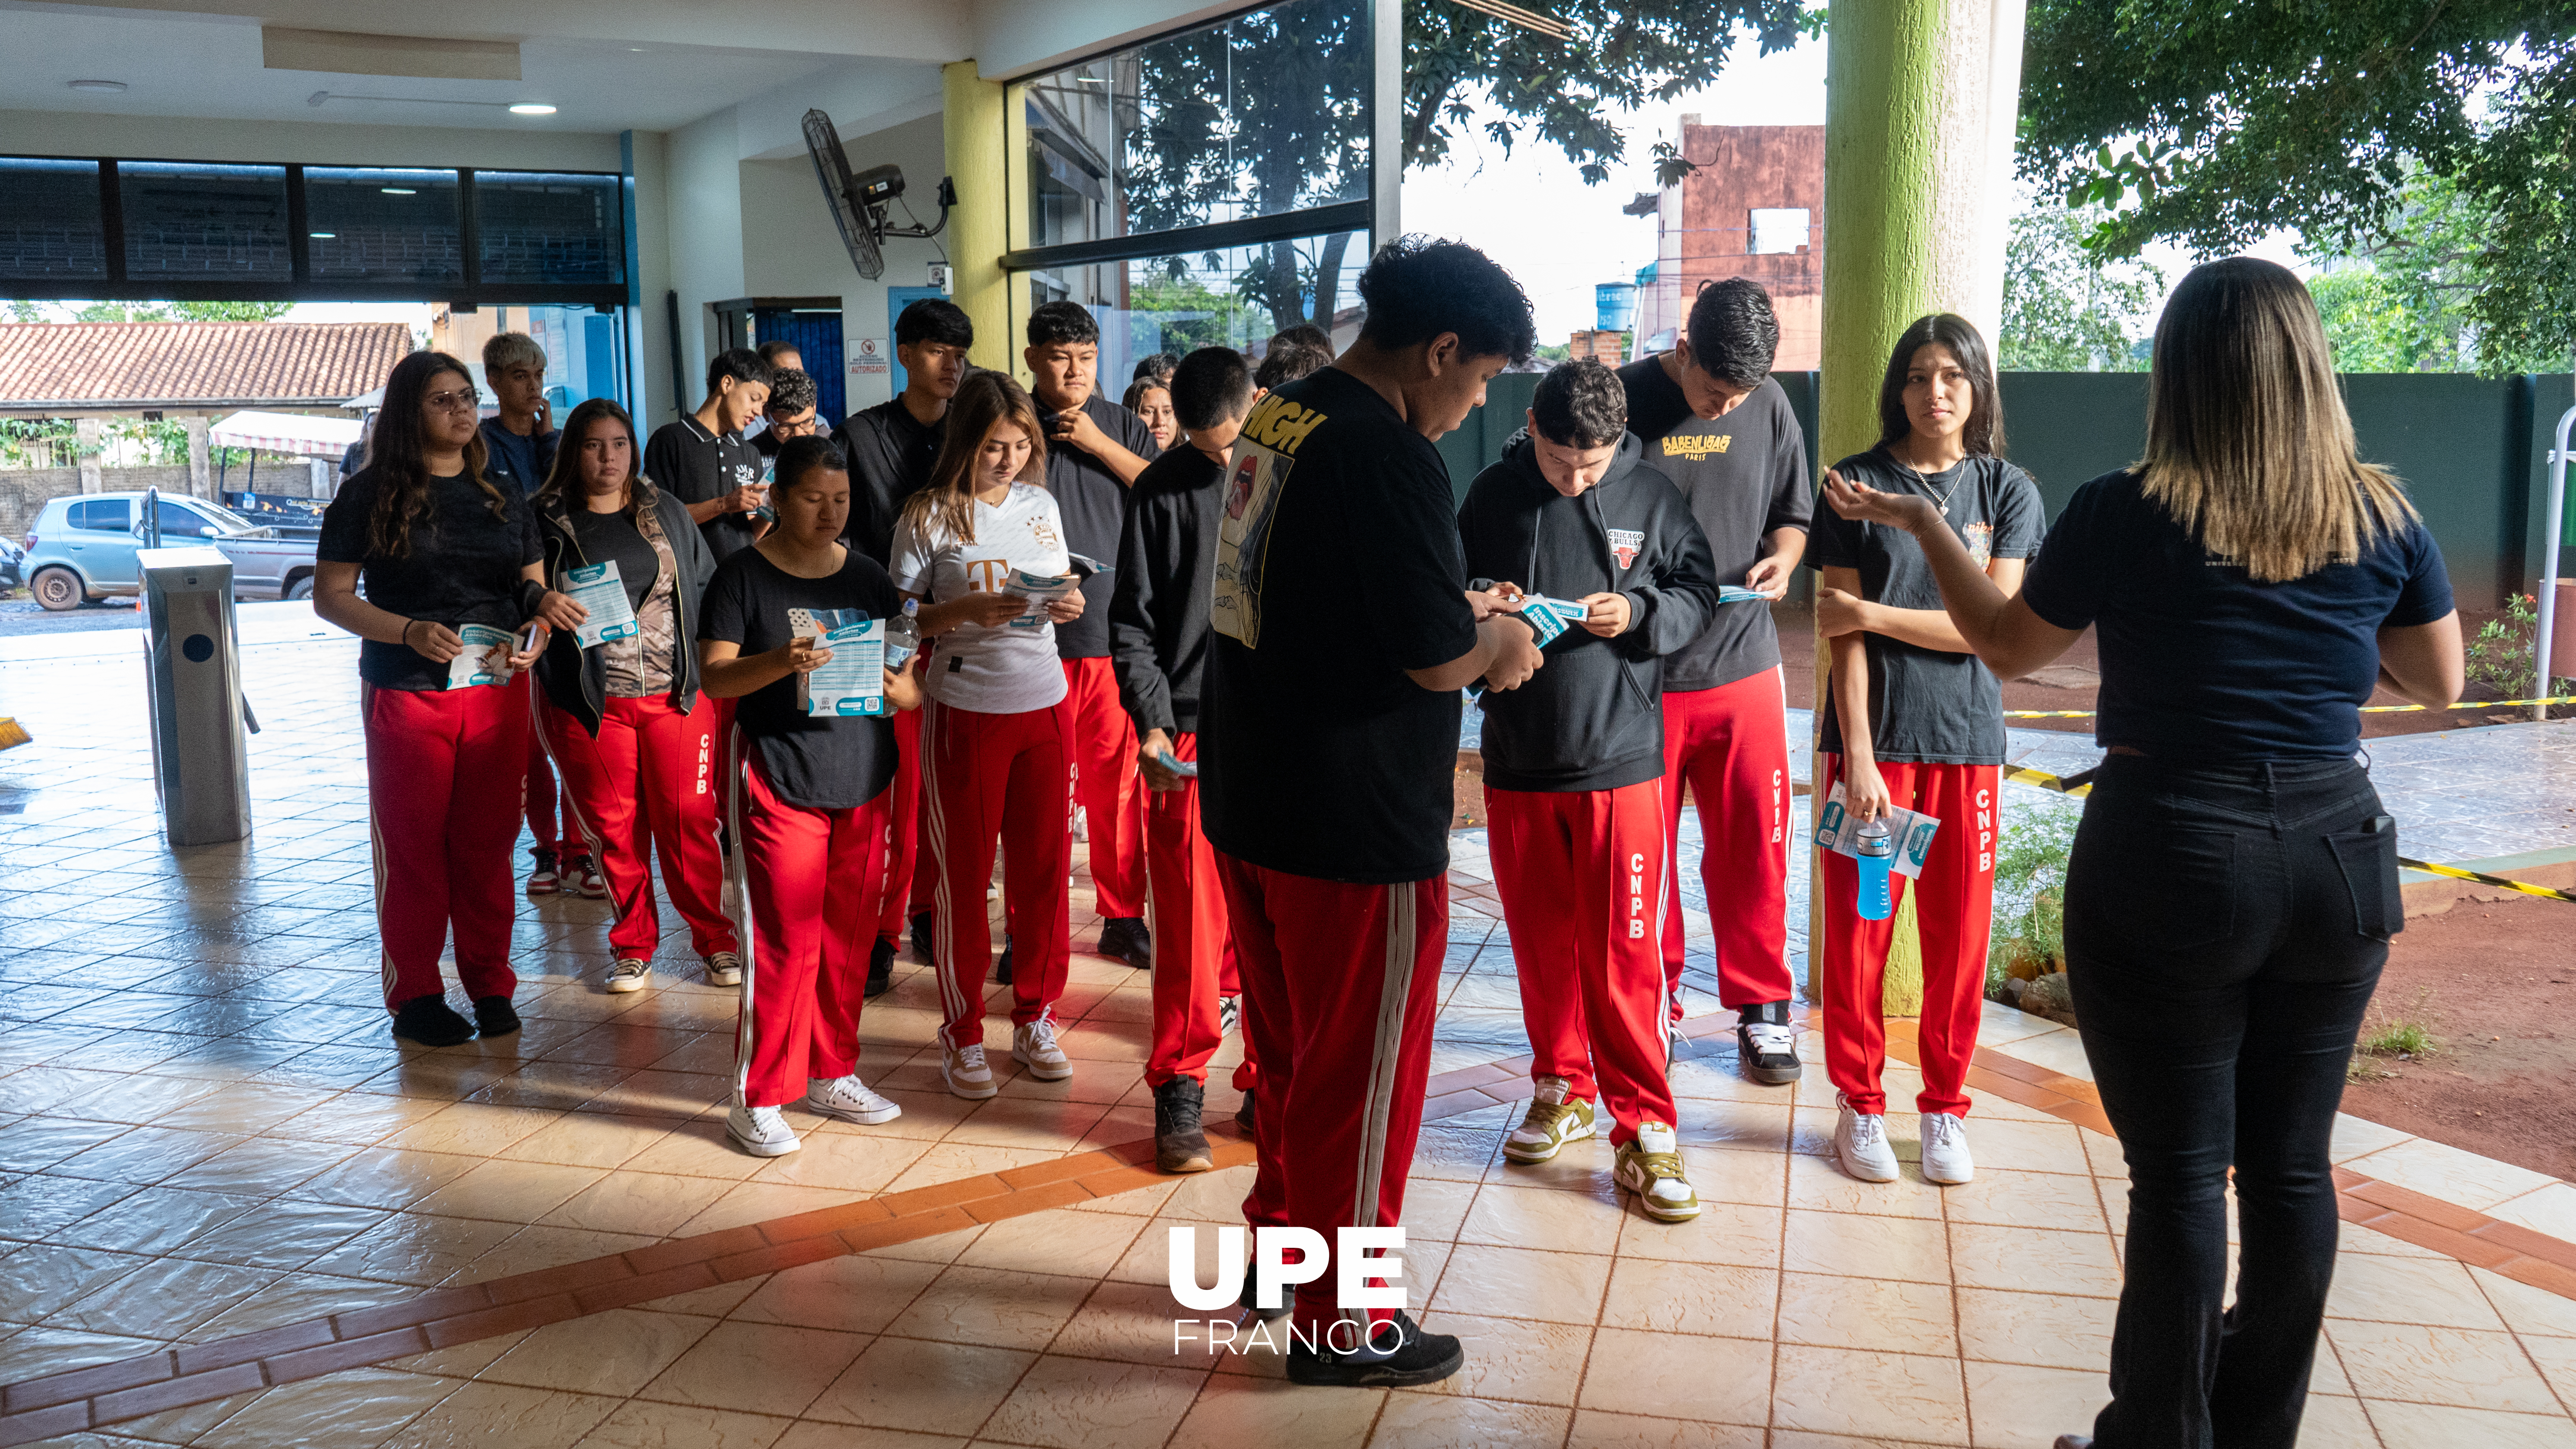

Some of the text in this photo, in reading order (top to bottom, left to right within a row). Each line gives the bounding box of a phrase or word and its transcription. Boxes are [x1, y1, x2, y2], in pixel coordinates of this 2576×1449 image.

[1240, 392, 1328, 455] HIGH
[1609, 531, 1643, 539] CHICAGO
[696, 734, 709, 794] CNPB
[1772, 770, 1781, 843] CNPB
[1976, 789, 1991, 873] CNPB
[1629, 854, 1644, 938] CNPB
[1320, 1352, 1331, 1363] 23
